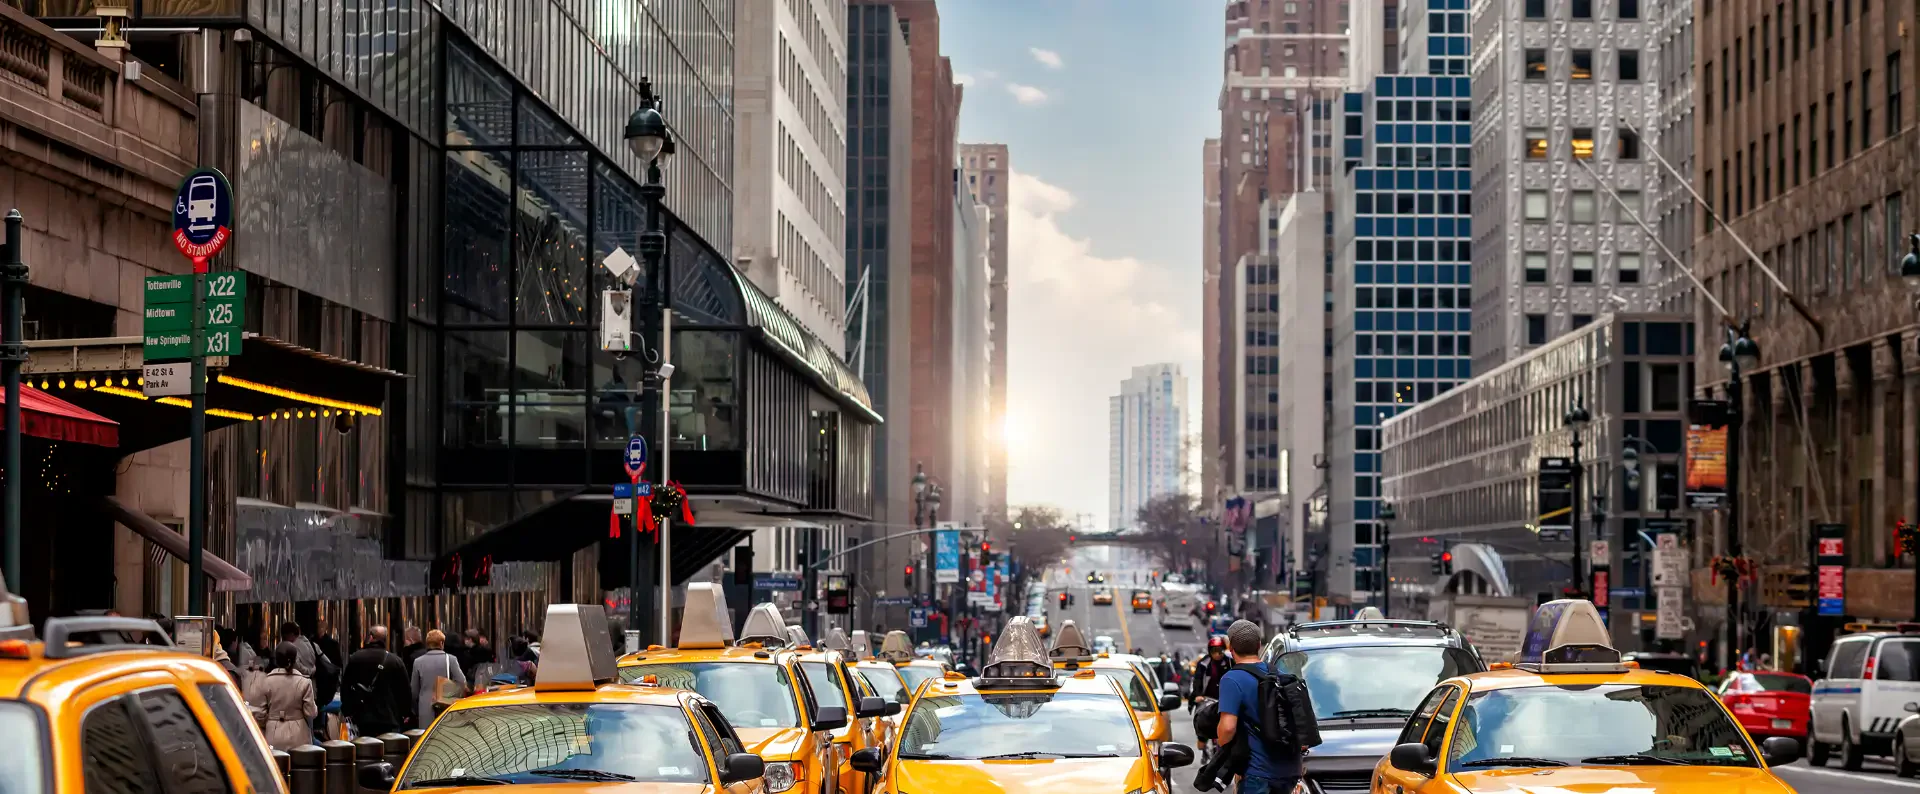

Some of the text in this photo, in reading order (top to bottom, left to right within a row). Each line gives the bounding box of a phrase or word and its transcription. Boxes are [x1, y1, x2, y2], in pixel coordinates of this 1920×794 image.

[176, 231, 225, 257] NO STANDING
[146, 280, 182, 290] Tottenville
[208, 275, 236, 297] x22
[146, 308, 176, 318] Midtown
[208, 304, 233, 325] x25
[146, 335, 191, 347] New Springville
[207, 332, 230, 353] x31
[146, 367, 174, 377] E 42 St &
[146, 379, 169, 389] Park Av
[755, 580, 785, 589] Lexington
